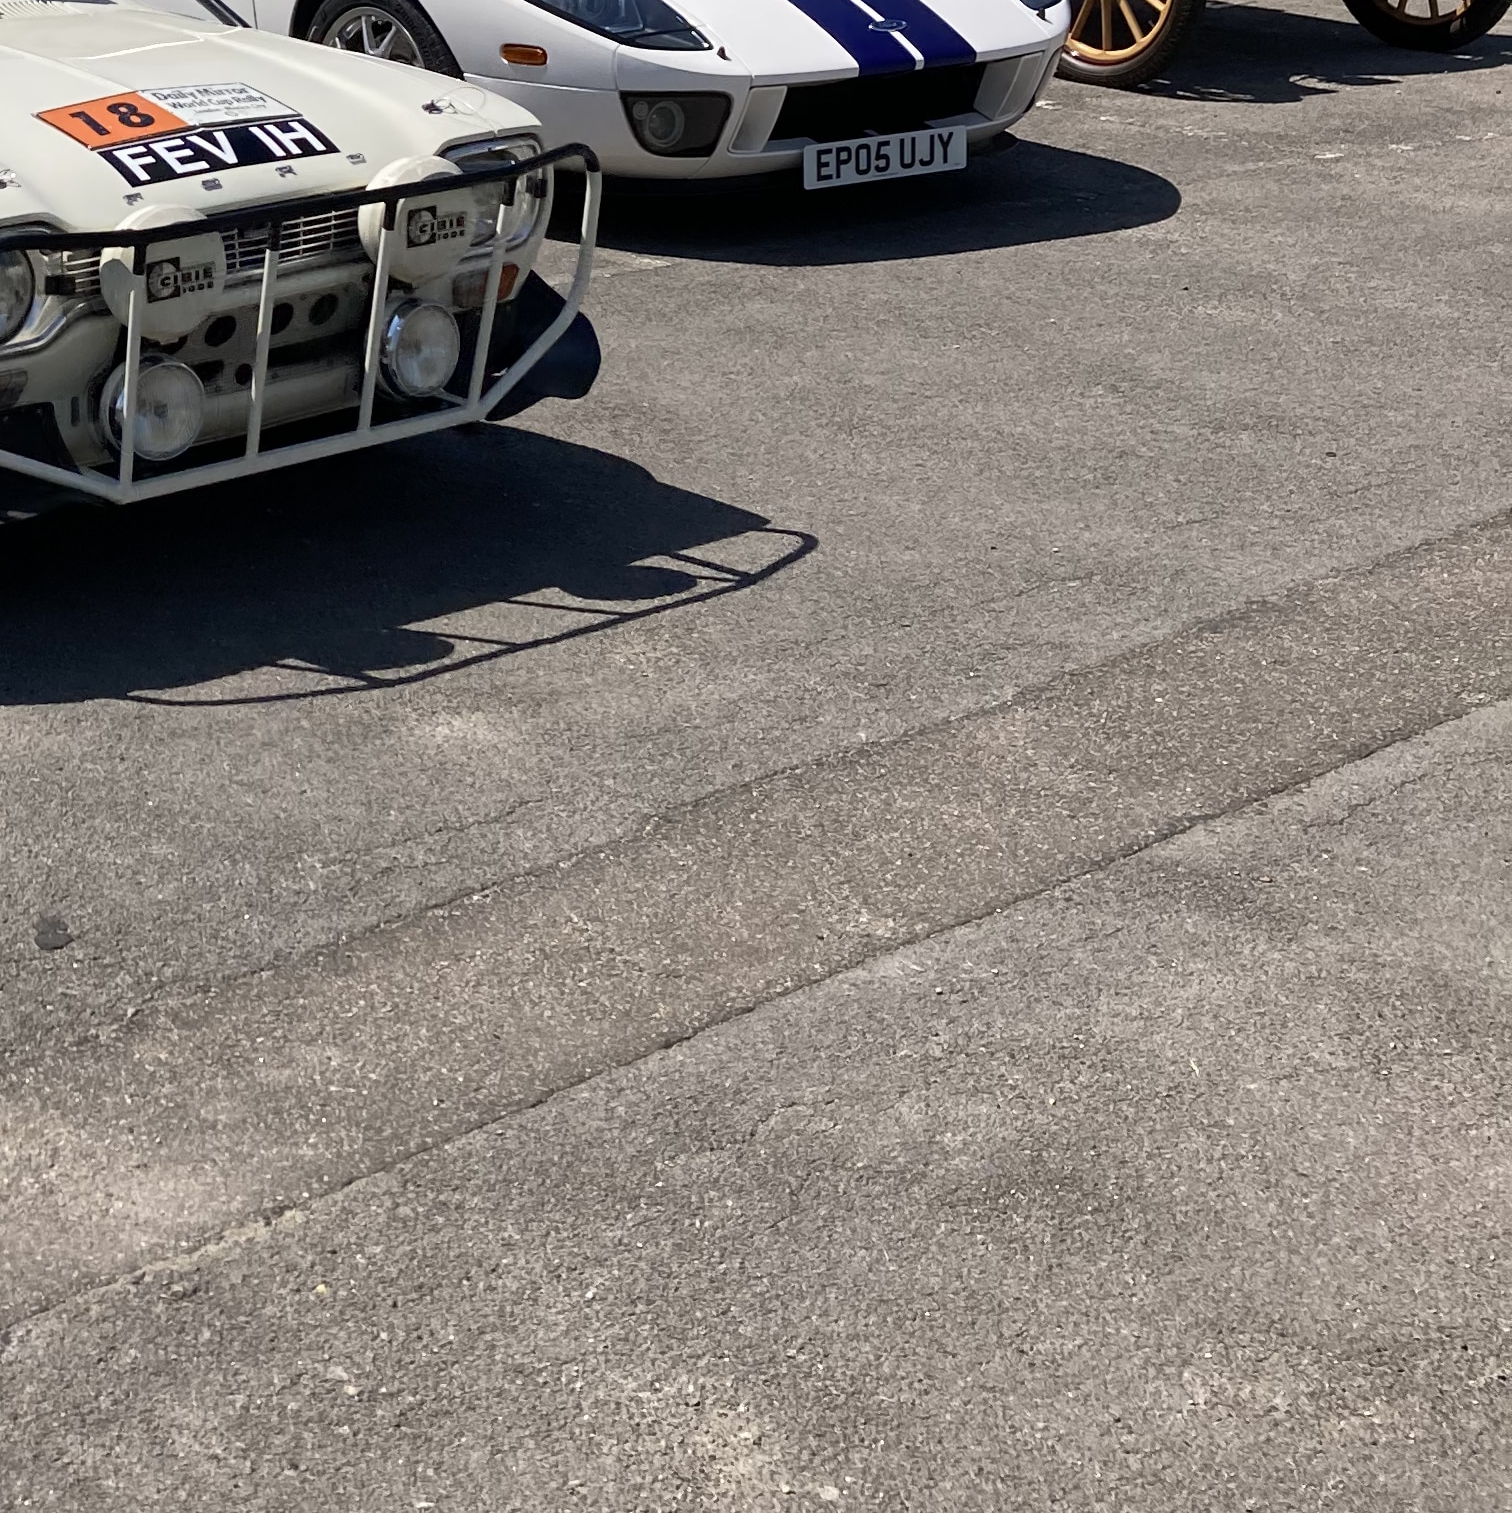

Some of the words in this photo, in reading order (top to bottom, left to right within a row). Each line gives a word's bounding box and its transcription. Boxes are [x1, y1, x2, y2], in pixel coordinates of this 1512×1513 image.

[152, 89, 199, 101] Daily
[194, 86, 251, 98] Mirror
[167, 98, 208, 110] World
[206, 97, 236, 107] Cup
[68, 102, 156, 136] 18
[112, 131, 238, 182] FEV
[816, 143, 891, 183] EP05
[899, 131, 954, 169] UJY
